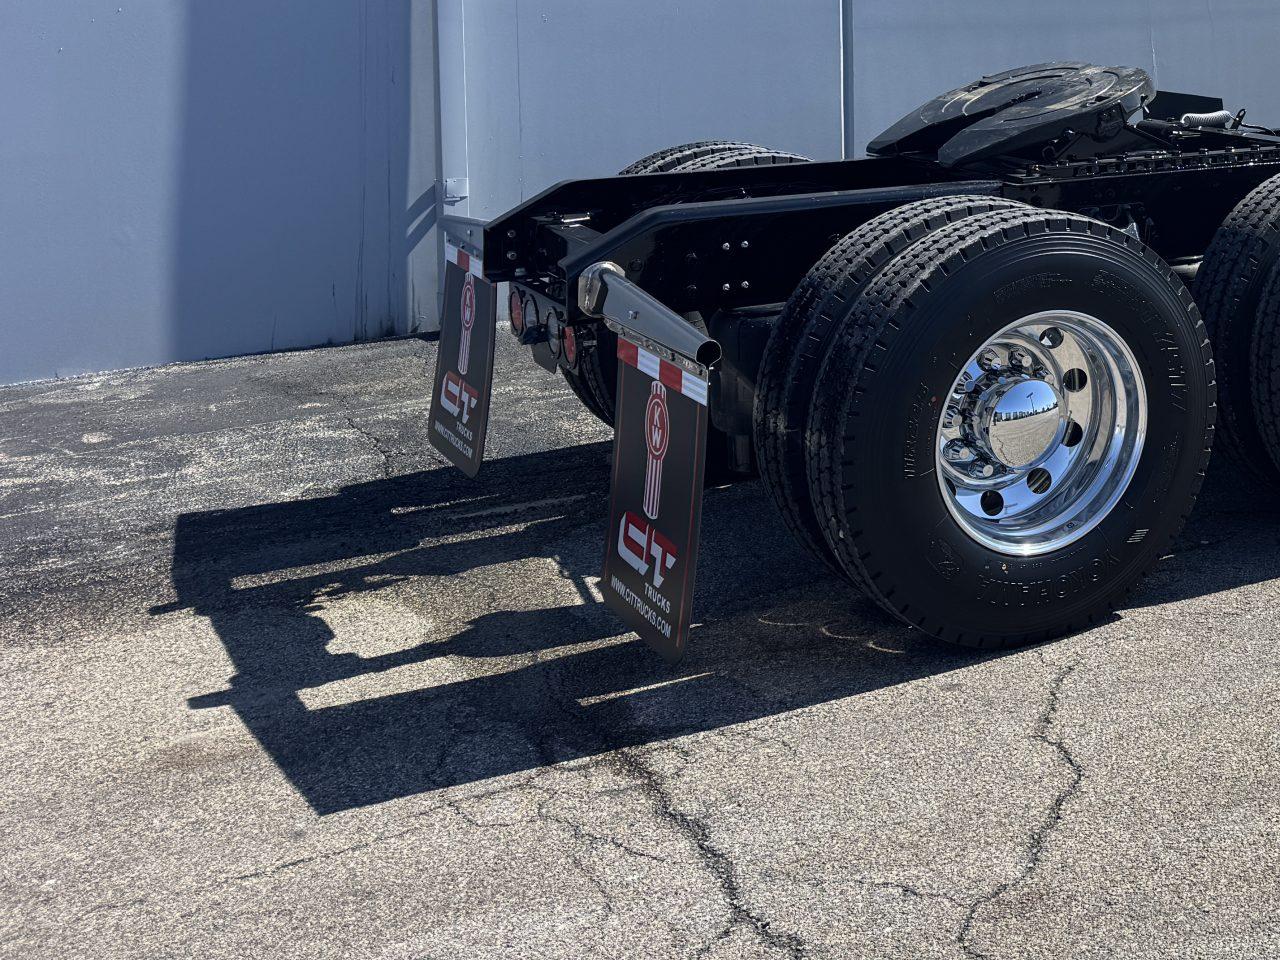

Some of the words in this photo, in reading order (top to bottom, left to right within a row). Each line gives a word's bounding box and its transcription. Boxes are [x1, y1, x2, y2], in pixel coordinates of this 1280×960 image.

[441, 370, 480, 424] CIT
[618, 511, 678, 588] CIT
[611, 573, 671, 639] WWW.CITTRUCKS.COM
[644, 582, 671, 614] TRUCKS
